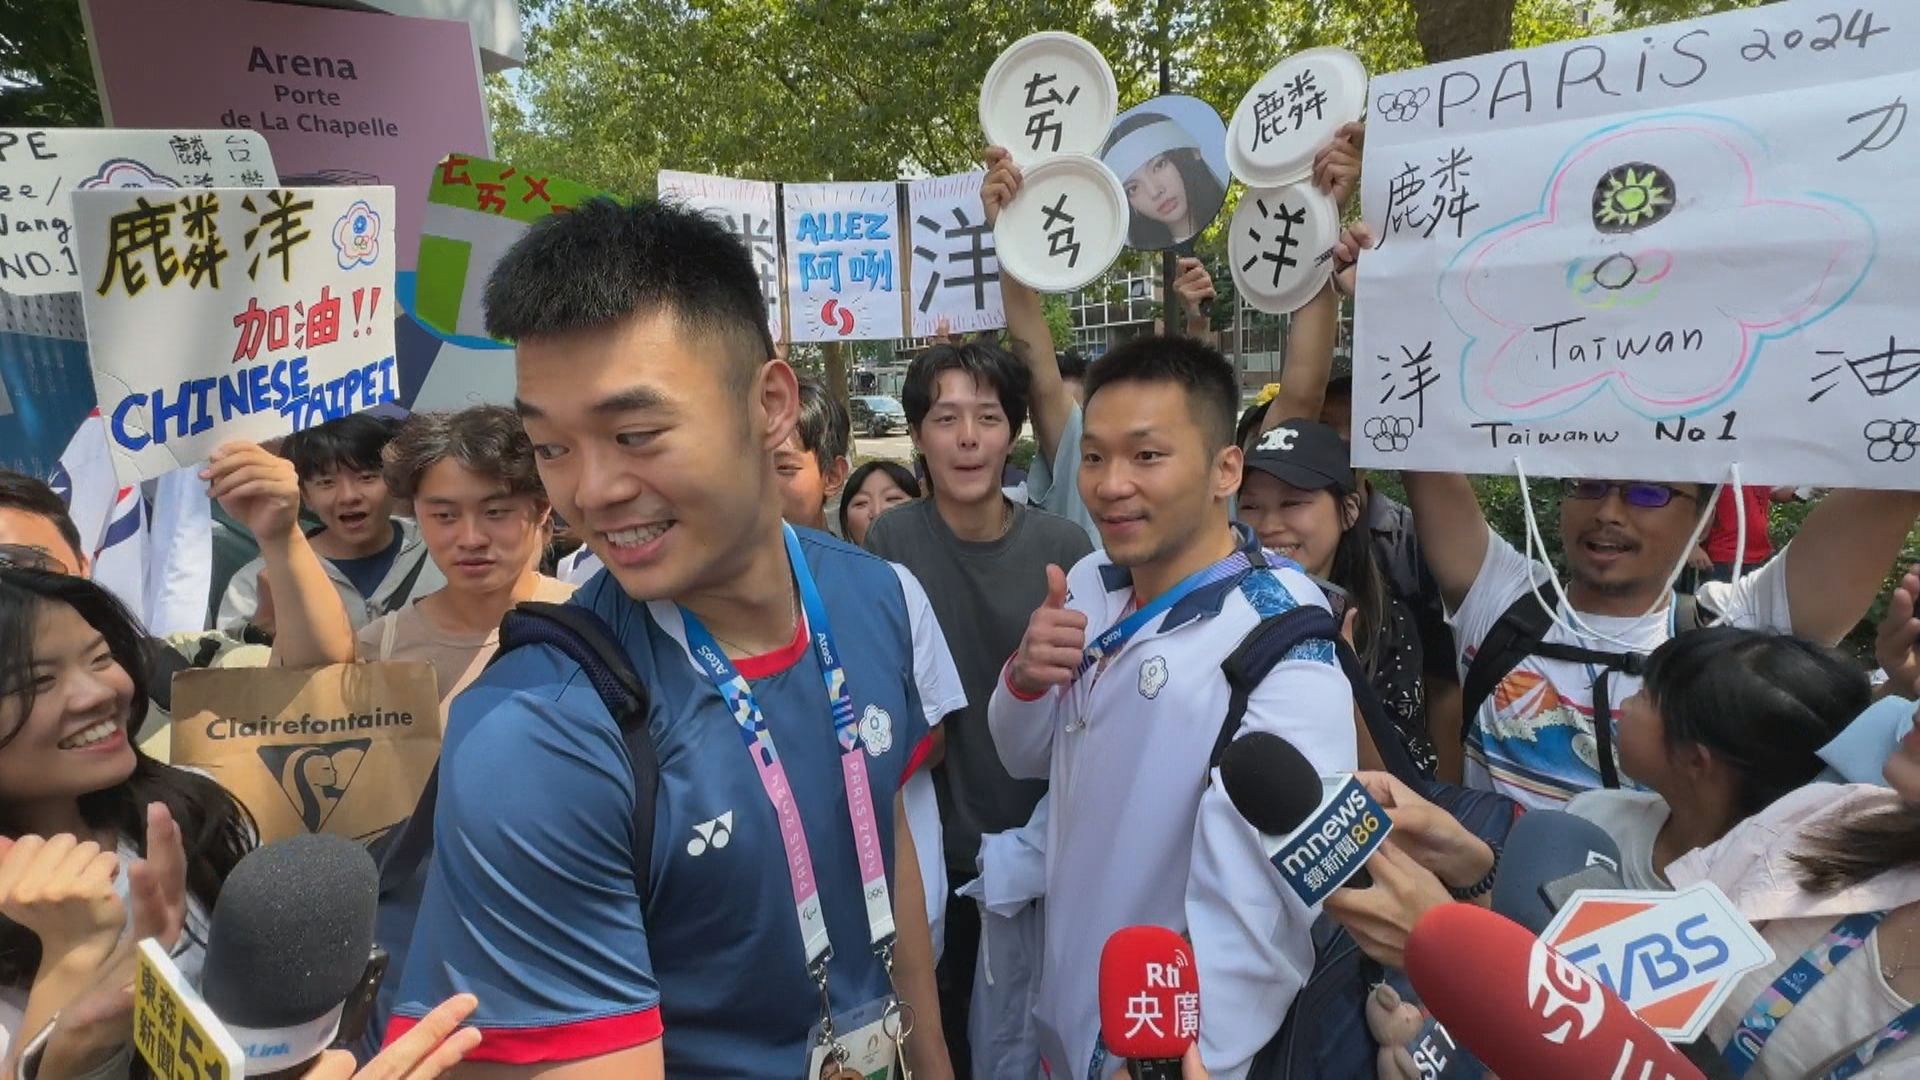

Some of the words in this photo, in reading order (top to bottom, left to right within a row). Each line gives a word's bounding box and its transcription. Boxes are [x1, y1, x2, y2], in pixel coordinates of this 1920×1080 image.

[248, 46, 358, 80] Arena
[1741, 10, 1891, 61] 2024
[220, 109, 251, 129] de
[261, 112, 289, 133] La
[298, 113, 399, 138] Chapelle
[274, 84, 341, 107] Porte
[1251, 69, 1328, 152] 麟
[797, 211, 891, 245] ALLEZ
[1375, 147, 1479, 251] 麟
[97, 189, 315, 297] 麟洋
[799, 250, 893, 292] 阿咧
[913, 207, 1000, 313] 洋
[1242, 198, 1306, 287] 洋
[1533, 317, 1704, 370] Taiwan
[111, 354, 310, 451] CHINESE
[280, 355, 396, 434] TAIPEI
[1378, 341, 1441, 428] 洋
[206, 708, 413, 741] Clairefontaine
[1282, 788, 1367, 877] mnews
[1124, 990, 1199, 1039] 央廣
